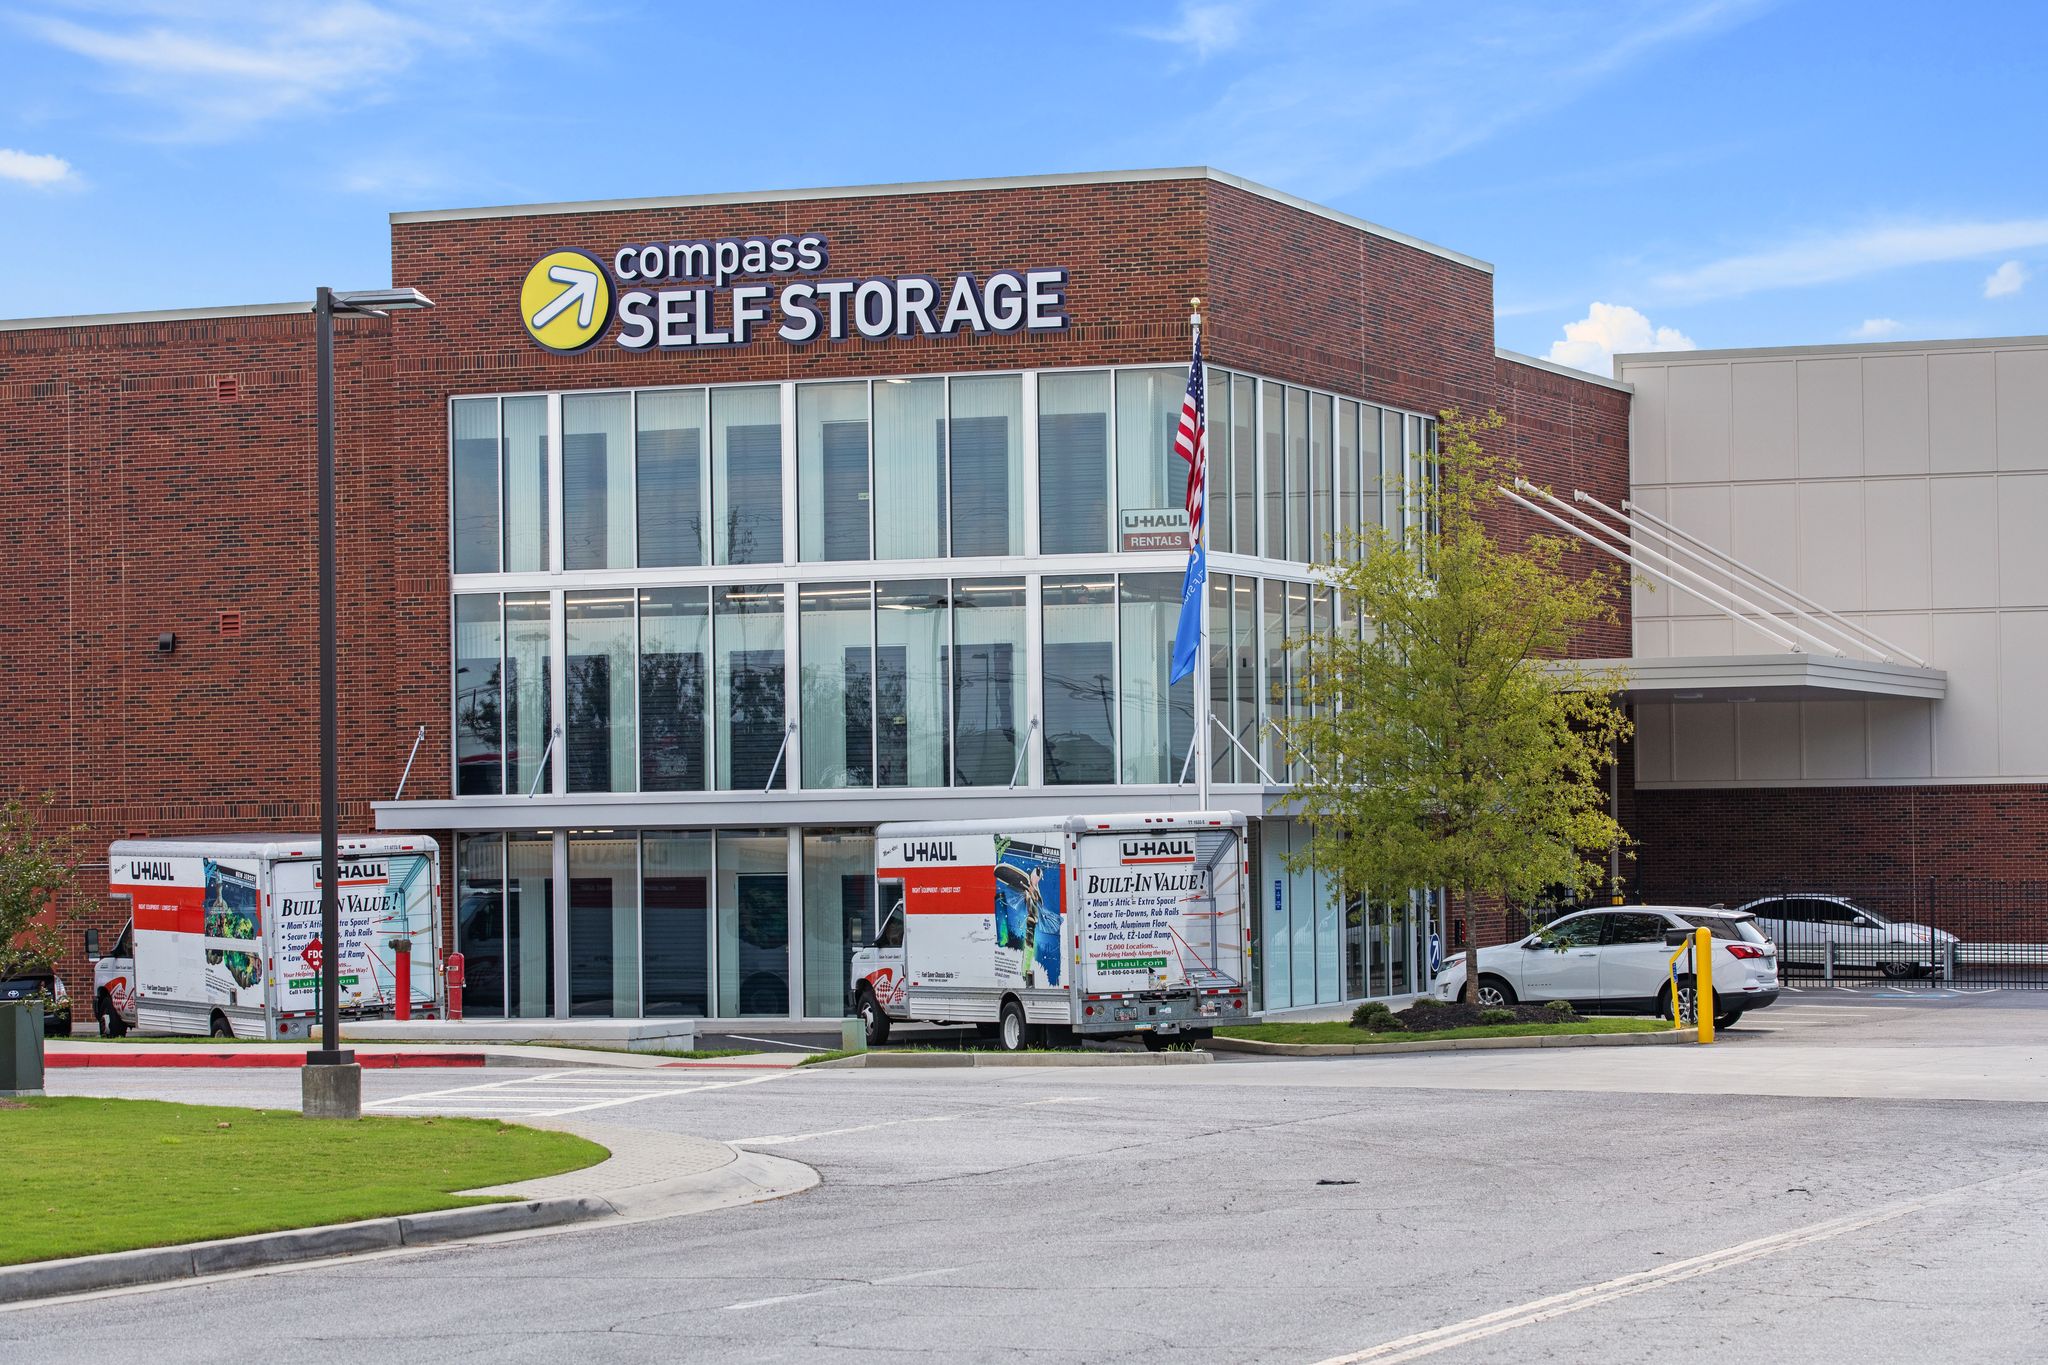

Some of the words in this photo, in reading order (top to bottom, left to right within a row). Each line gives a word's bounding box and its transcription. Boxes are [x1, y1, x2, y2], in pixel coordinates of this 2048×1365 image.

[615, 236, 824, 287] compass
[616, 285, 769, 348] SELF
[778, 270, 1064, 342] STORAGE
[1124, 514, 1188, 528] U-HAUL
[1130, 535, 1182, 547] RENTALS
[903, 841, 958, 862] U-HAUL
[1122, 840, 1195, 857] U-HAUL
[130, 861, 175, 882] U-HAUL
[316, 863, 387, 880] HAUL
[1087, 873, 1153, 894] BUILT-IN
[1153, 870, 1206, 892] VALUE!
[280, 898, 346, 917] BUILTN
[346, 892, 400, 914] VALUE!
[1092, 899, 1114, 908] Mom's
[1115, 898, 1131, 907] Attic
[1137, 897, 1156, 906] Extra
[1156, 896, 1177, 906] Space!
[1093, 910, 1113, 919] Secure
[1115, 909, 1149, 919] Tie-Downs,
[1150, 908, 1163, 917] Rub
[1164, 908, 1180, 916] Rails
[286, 921, 308, 930] Mom's
[309, 920, 323, 929] Atti
[350, 917, 370, 928] Space!
[1093, 922, 1119, 931] Smooth,
[1120, 920, 1151, 929] Aluminum
[1152, 919, 1168, 928] Floor
[287, 932, 307, 941] Secure
[344, 928, 357, 937] Rub
[357, 927, 373, 936] Rails
[1093, 932, 1107, 941] Low
[1108, 931, 1126, 941] Deck,
[1154, 931, 1172, 942] Ramp
[345, 940, 362, 948] Floor
[347, 950, 366, 960] Ramp
[1101, 951, 1121, 960] Helping
[1121, 950, 1137, 958] Hands
[1137, 950, 1153, 959] Along
[1110, 958, 1164, 968] uhaul.com
[1107, 968, 1148, 976] 1-800-GO-U-HAUL
